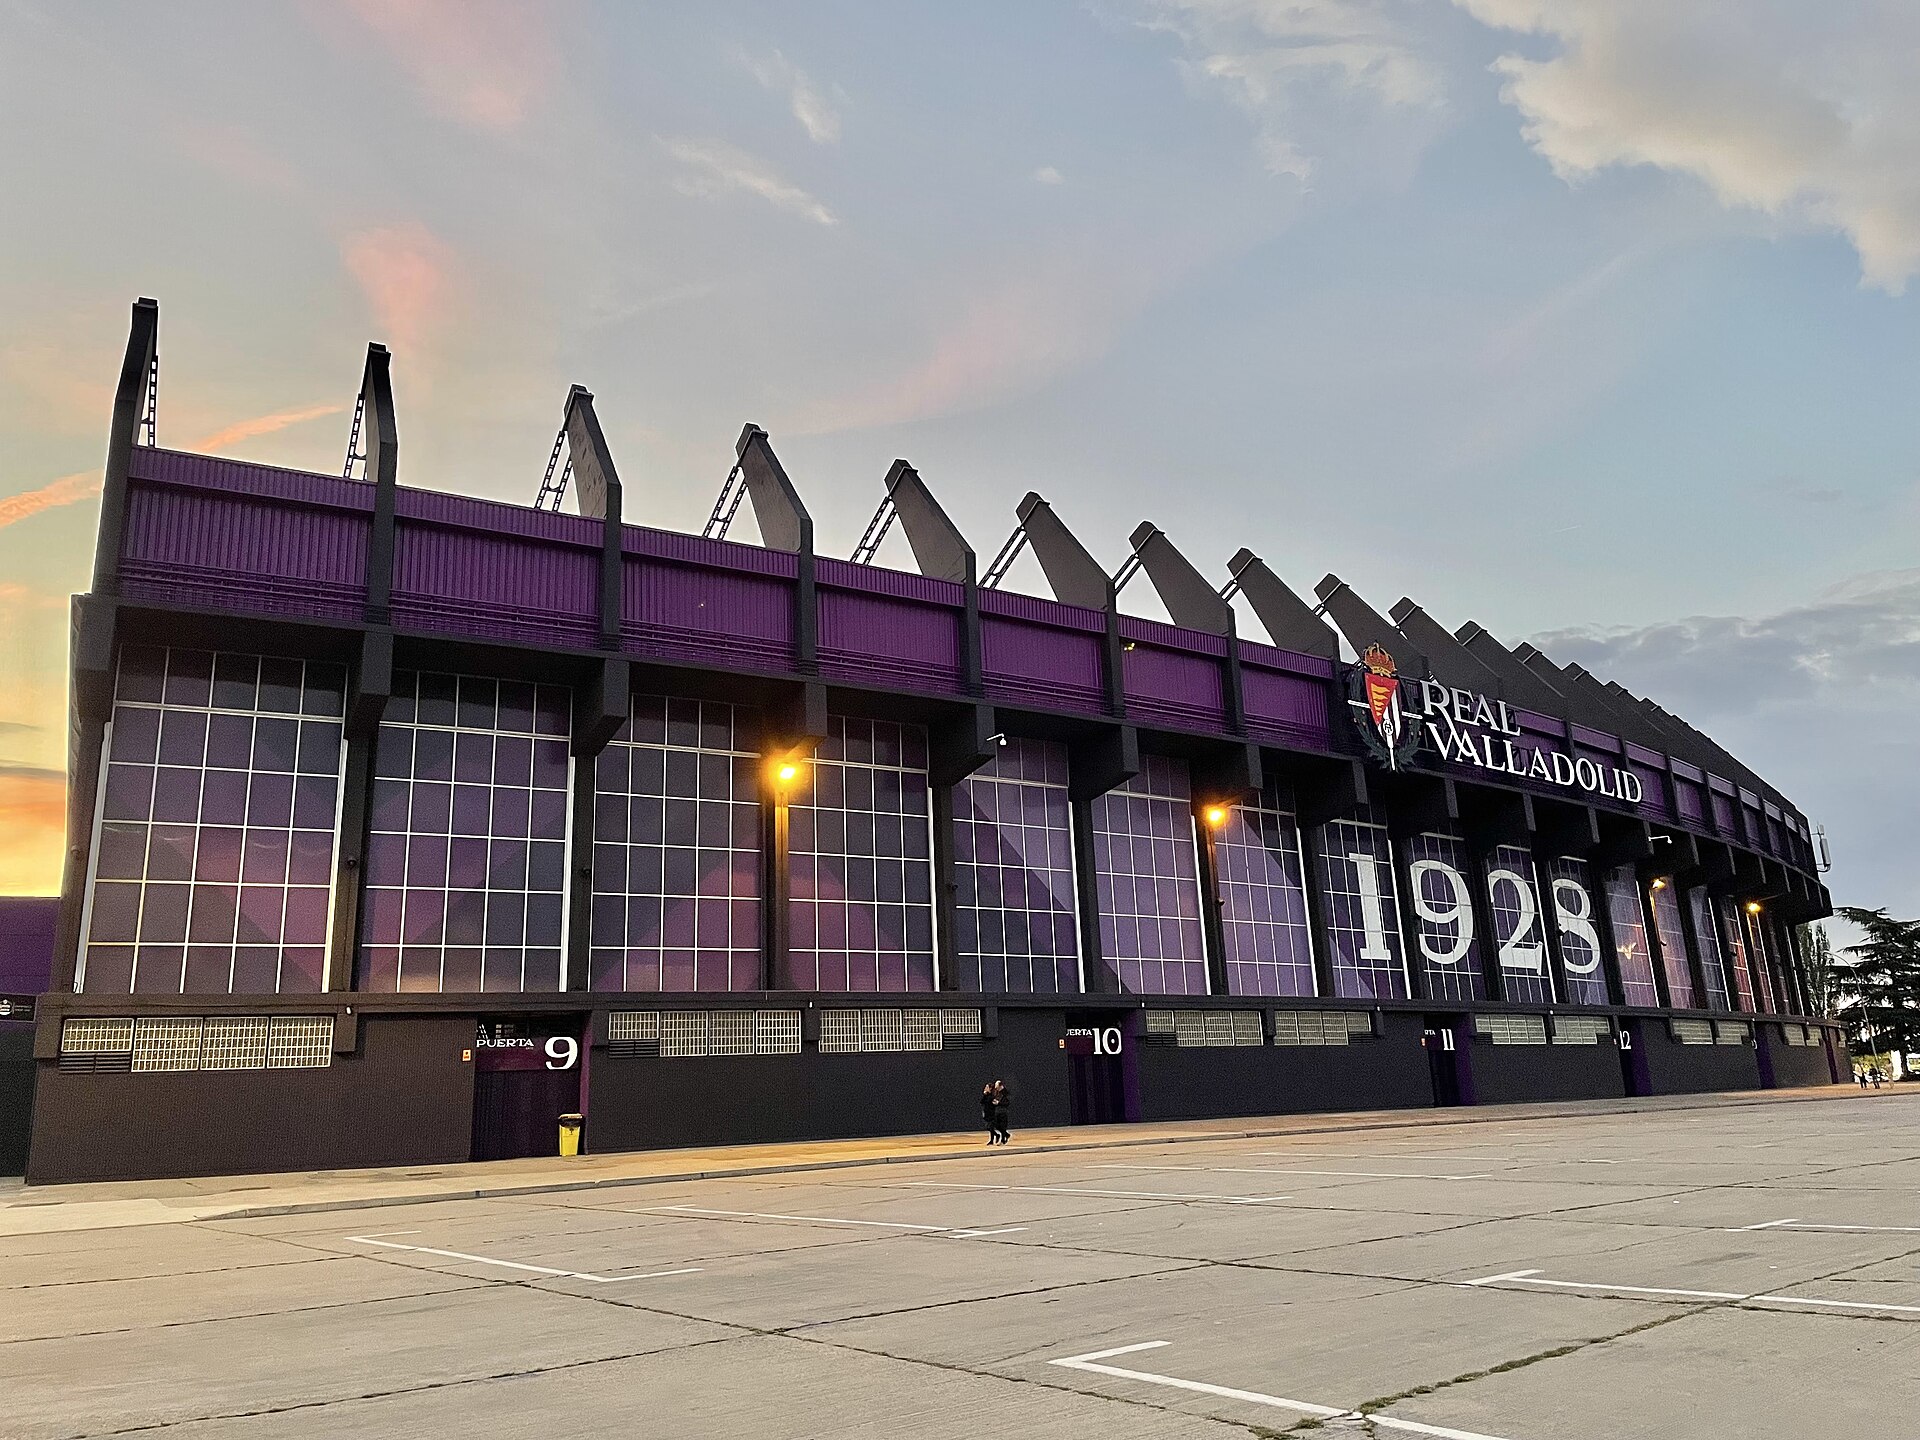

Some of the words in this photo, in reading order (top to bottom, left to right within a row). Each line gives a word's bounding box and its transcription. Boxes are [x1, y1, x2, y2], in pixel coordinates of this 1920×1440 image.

[1420, 680, 1520, 736] REAL
[1426, 722, 1643, 803] VALLADOLID
[1348, 852, 1601, 976] 1928
[476, 1038, 534, 1048] PUERTA
[544, 1036, 578, 1070] 9
[1066, 1028, 1092, 1036] ERTA
[1092, 1027, 1122, 1054] 10
[1441, 1028, 1455, 1050] 11
[1619, 1030, 1632, 1049] 12
